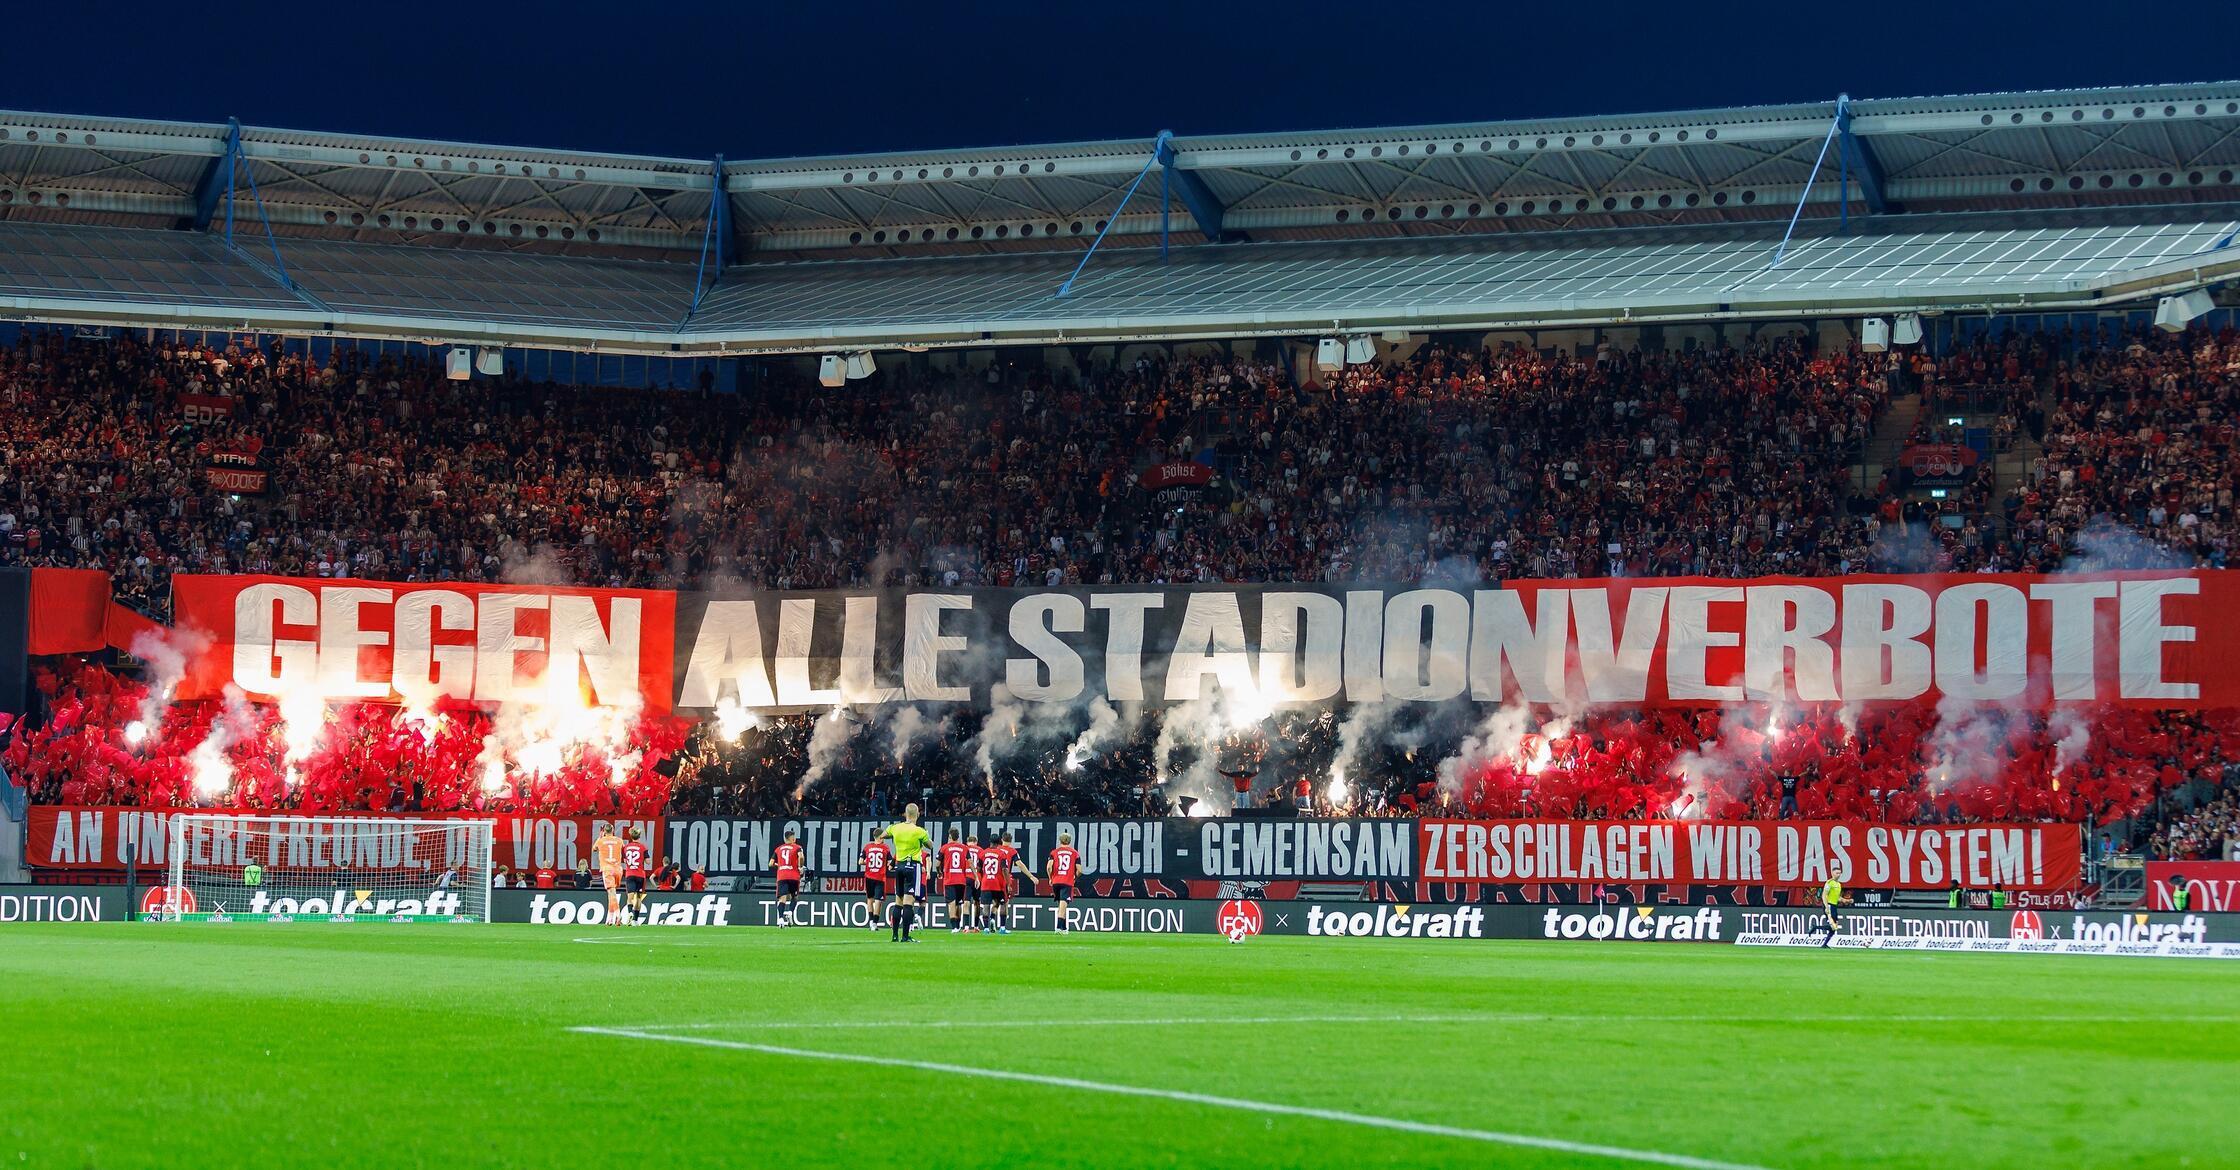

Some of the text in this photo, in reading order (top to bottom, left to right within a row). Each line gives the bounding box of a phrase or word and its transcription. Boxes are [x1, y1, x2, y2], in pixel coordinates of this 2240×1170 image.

[232, 578, 2200, 707] GEGEN ALLE STADIONVERBOTE
[50, 811, 103, 863] AN
[117, 811, 255, 866] UNSERE
[511, 818, 578, 870] VOR
[669, 820, 771, 872] TOREN
[1200, 822, 1410, 877] GEMEINSAM
[1423, 823, 1675, 880] ZERSCHLAGEN
[1688, 825, 1764, 881] WIR
[1777, 826, 1853, 883] DAS
[1866, 827, 2044, 885] SYSTEM!
[781, 849, 791, 865] 4
[625, 850, 641, 866] 32
[867, 852, 883, 868] 36
[951, 851, 961, 869] 8
[984, 857, 999, 875] 23
[1058, 854, 1071, 871] 19
[250, 889, 461, 914] toolcraft
[2153, 879, 2240, 912] NOV
[0, 895, 101, 921] DITION
[759, 900, 947, 928] TCHNOOIE
[1048, 904, 1184, 932] TRADITION
[1307, 905, 1484, 938] toolcraft
[1544, 907, 1722, 941] toolcraft
[1742, 913, 1843, 936] TECHNOLOGE
[1902, 919, 1989, 939] TRADITION
[2072, 914, 2208, 943] toolcraft
[1740, 934, 1781, 944] toolcraft
[1788, 936, 1827, 946] toolcraf
[1836, 937, 1874, 947] toolcr
[1881, 938, 1919, 948] toolcraft
[1926, 940, 1964, 949] toolcraft
[1971, 941, 2010, 951] toolcraft
[2018, 942, 2058, 952] toolcraft
